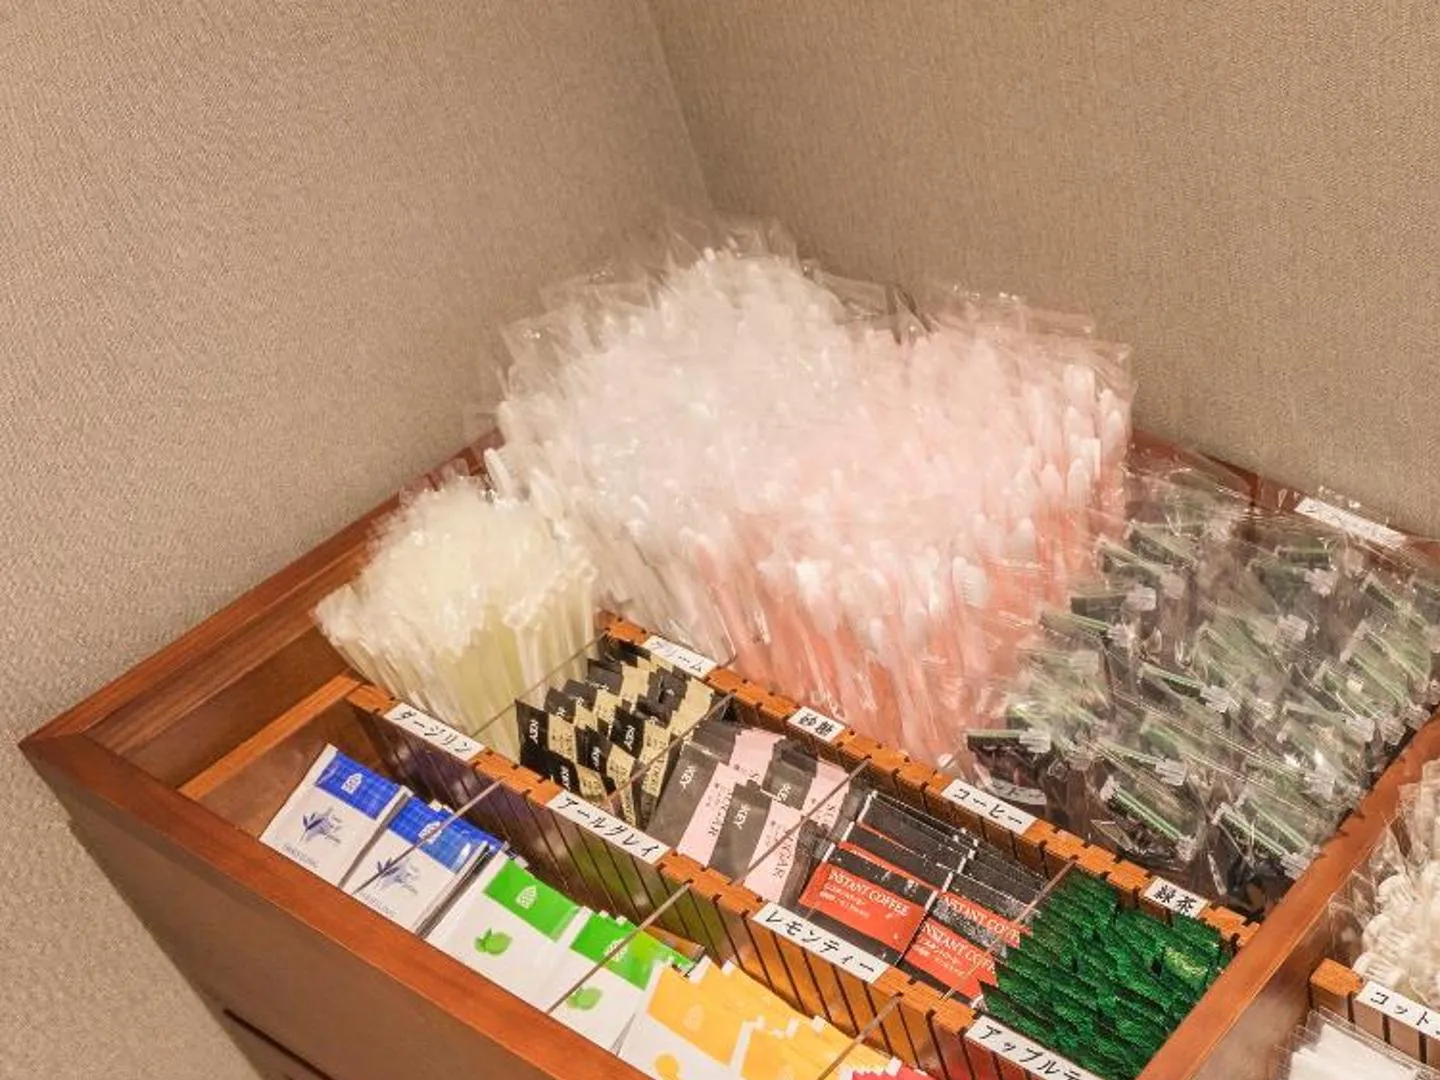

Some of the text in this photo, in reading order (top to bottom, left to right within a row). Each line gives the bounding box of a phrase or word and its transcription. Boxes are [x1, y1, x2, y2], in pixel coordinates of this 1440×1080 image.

[396, 708, 473, 752] ダージリン
[557, 796, 660, 859] アールグレイ
[953, 788, 1022, 826] コーヒー
[1154, 885, 1196, 914] 緑茶
[766, 911, 874, 972] レモンティー
